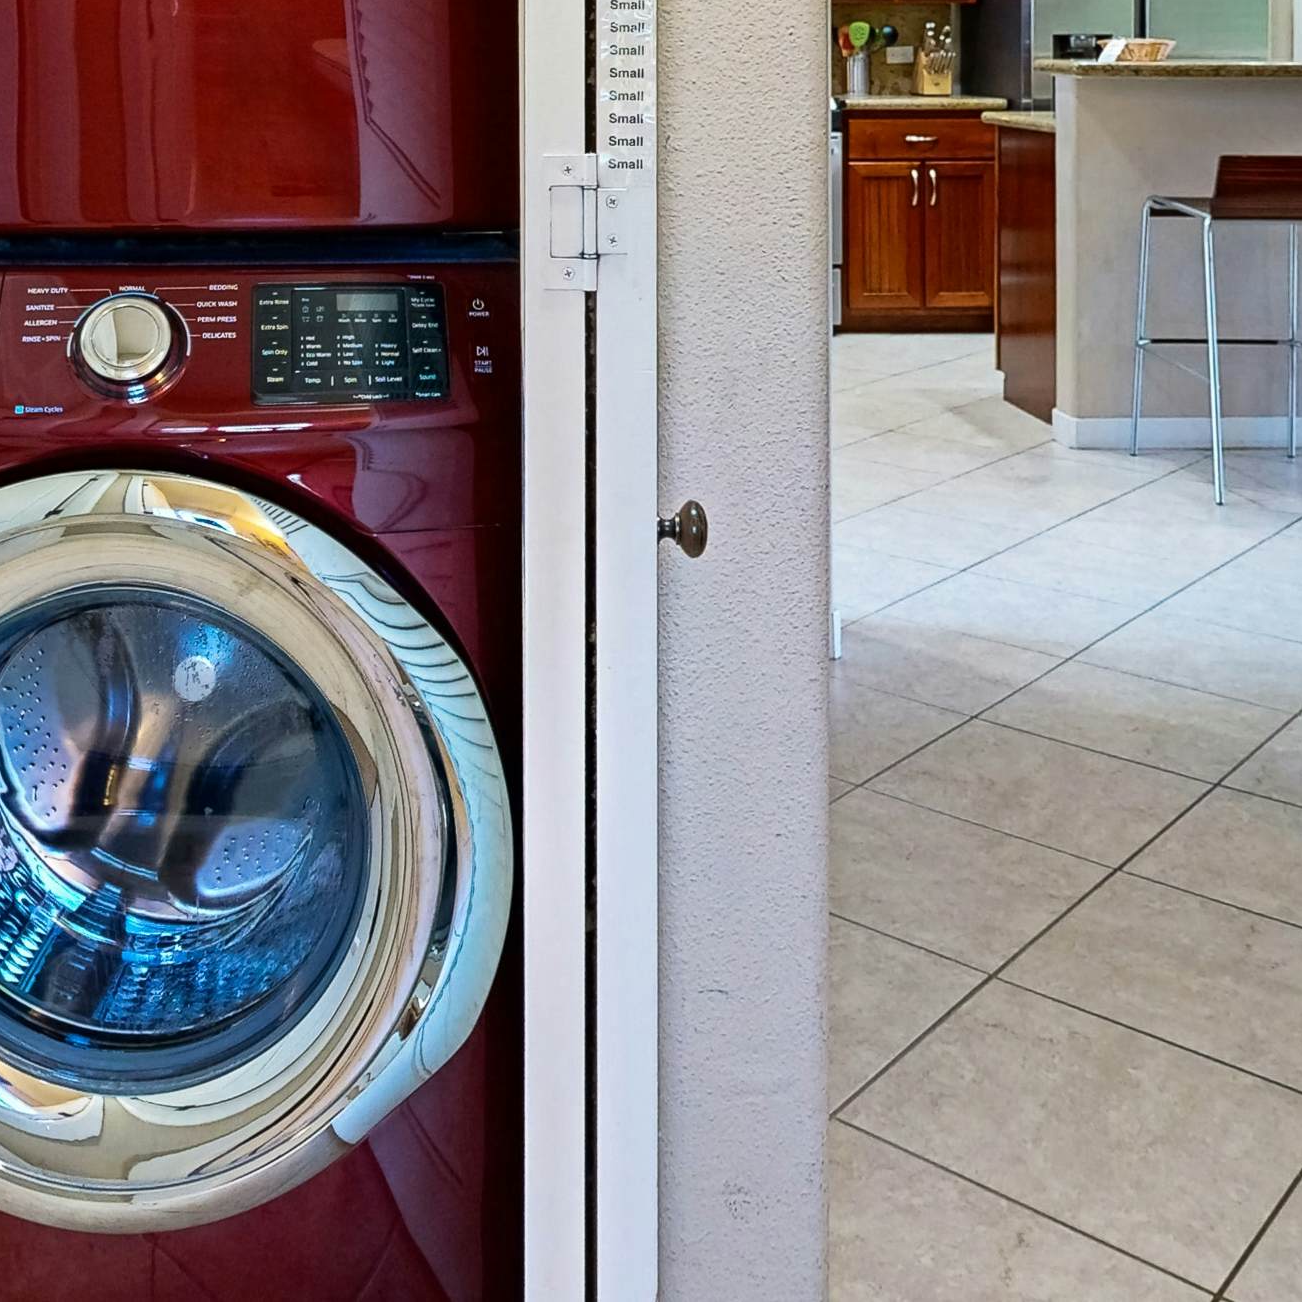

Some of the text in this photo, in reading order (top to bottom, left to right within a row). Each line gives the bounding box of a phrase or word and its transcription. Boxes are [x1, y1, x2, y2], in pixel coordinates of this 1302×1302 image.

[610, 0, 645, 11] Small
[609, 68, 644, 80] Small
[609, 90, 644, 102] Small
[609, 113, 644, 125] Small
[608, 136, 643, 148] Small
[608, 158, 643, 171] Small
[50, 287, 69, 295] DUTY
[119, 285, 146, 293] NORMAL
[196, 300, 217, 308] QUICK
[216, 315, 237, 323] PRESS
[202, 331, 237, 339] DELICATES
